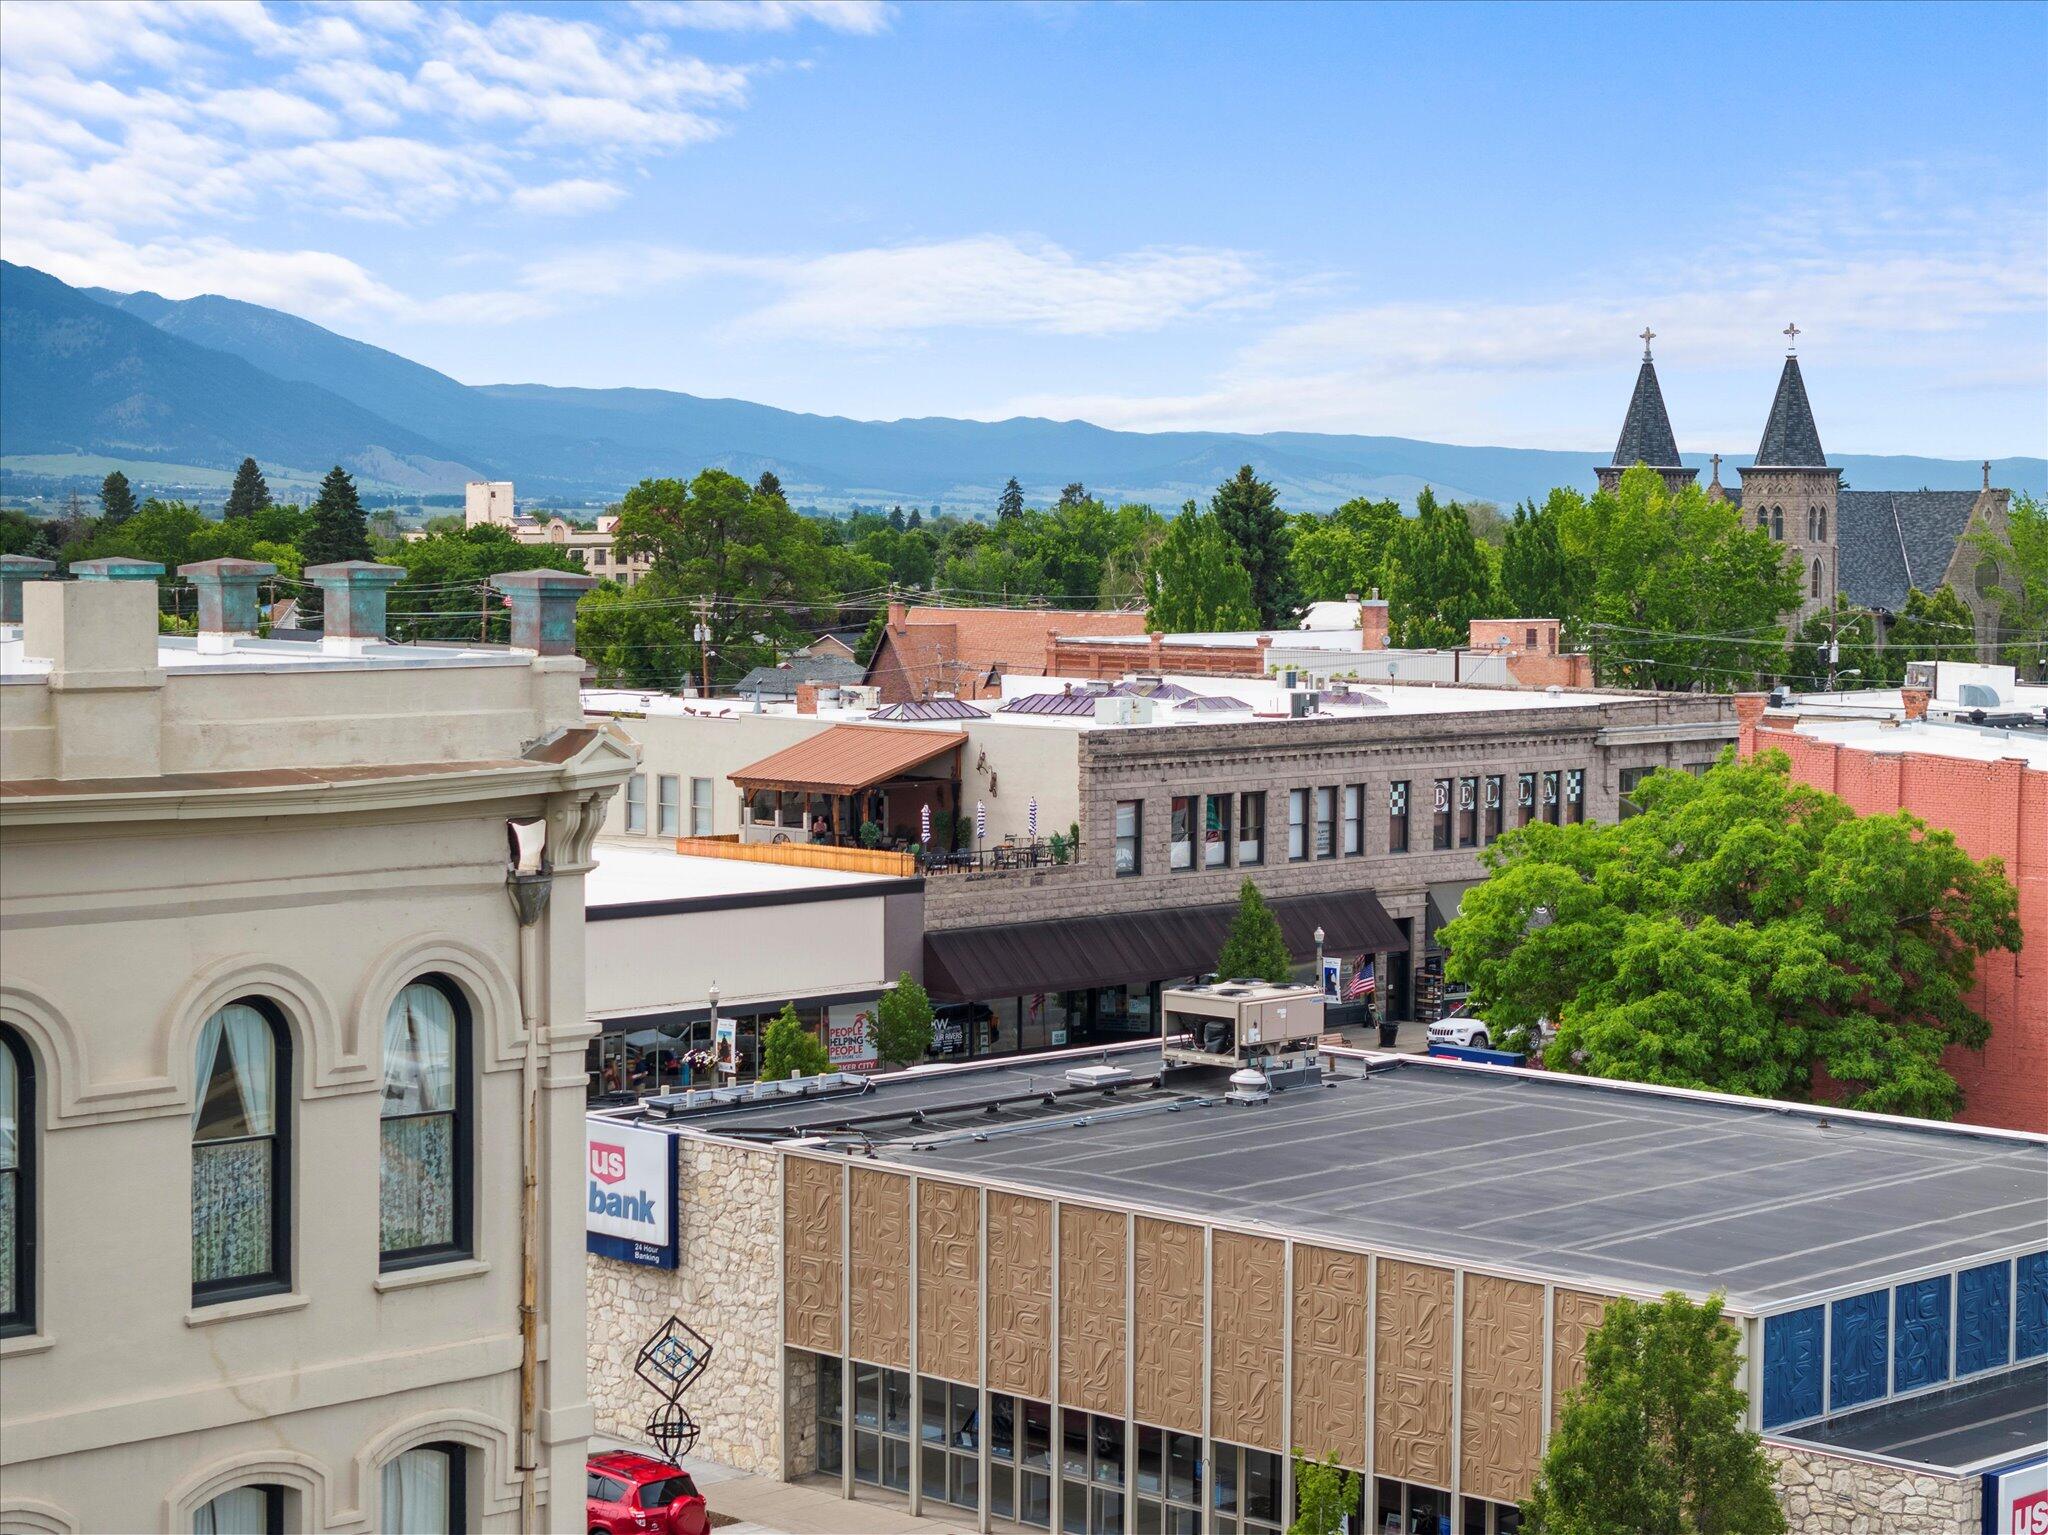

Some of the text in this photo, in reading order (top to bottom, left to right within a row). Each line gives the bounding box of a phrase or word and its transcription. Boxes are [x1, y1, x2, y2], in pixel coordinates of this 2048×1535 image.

[830, 1026, 863, 1038] PEOPLE
[830, 1036, 864, 1047] HELPING
[830, 1045, 863, 1056] PEOPLE
[857, 1061, 875, 1070] CITY
[589, 1181, 656, 1225] bank
[634, 1242, 659, 1254] 24 Hour
[634, 1250, 660, 1263] Banking
